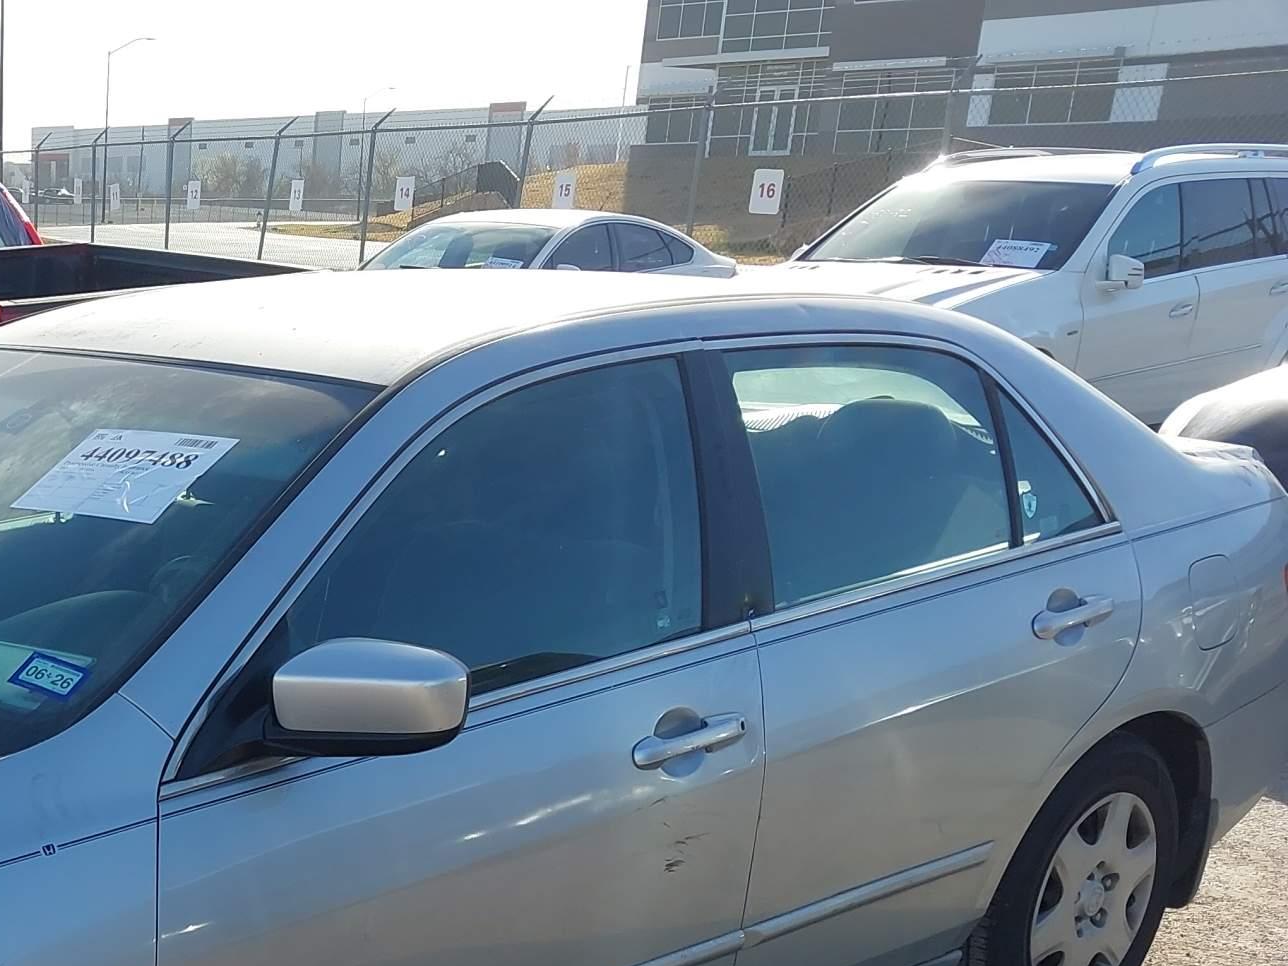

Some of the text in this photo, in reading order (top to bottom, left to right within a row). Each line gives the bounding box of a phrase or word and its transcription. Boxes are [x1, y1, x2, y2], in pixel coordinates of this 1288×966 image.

[190, 189, 199, 200] 12
[399, 187, 410, 199] 14
[559, 183, 572, 198] 15
[759, 182, 776, 199] 16
[80, 446, 199, 470] 44097488
[25, 665, 74, 689] 06 26
